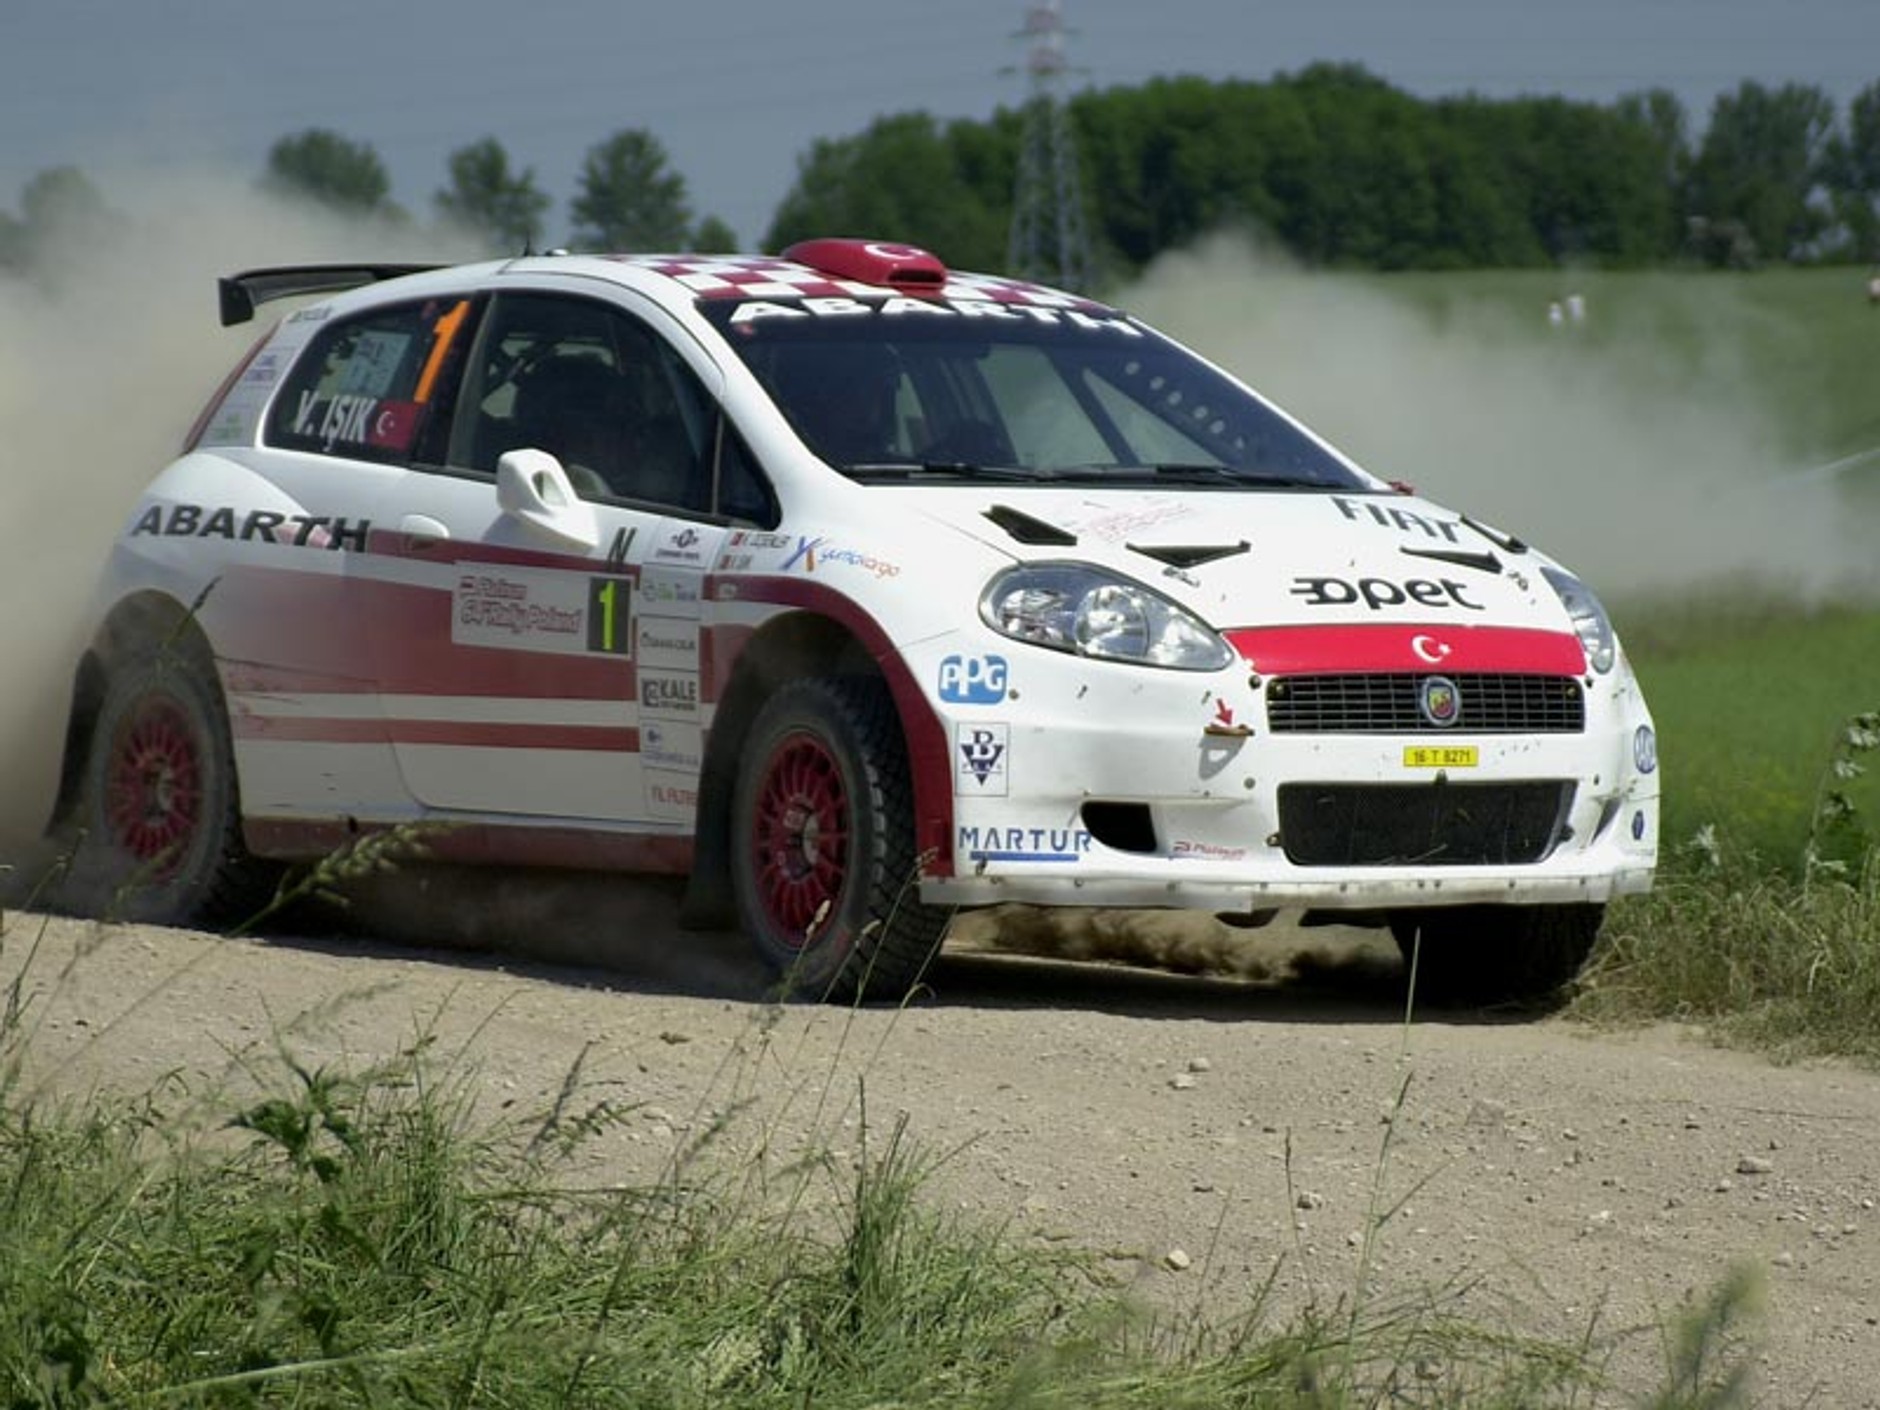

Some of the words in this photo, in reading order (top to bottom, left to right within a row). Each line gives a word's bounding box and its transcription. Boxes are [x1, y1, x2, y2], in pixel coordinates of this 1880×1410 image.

[729, 297, 1143, 338] ABARTH
[412, 300, 471, 403] 1
[292, 389, 318, 435] V.
[131, 504, 371, 553] ABARTH
[1330, 496, 1460, 544] FIAT
[598, 579, 616, 651] 1
[660, 679, 697, 701] KALE
[940, 655, 1005, 697] PPG
[958, 827, 1093, 851] MARTUR
